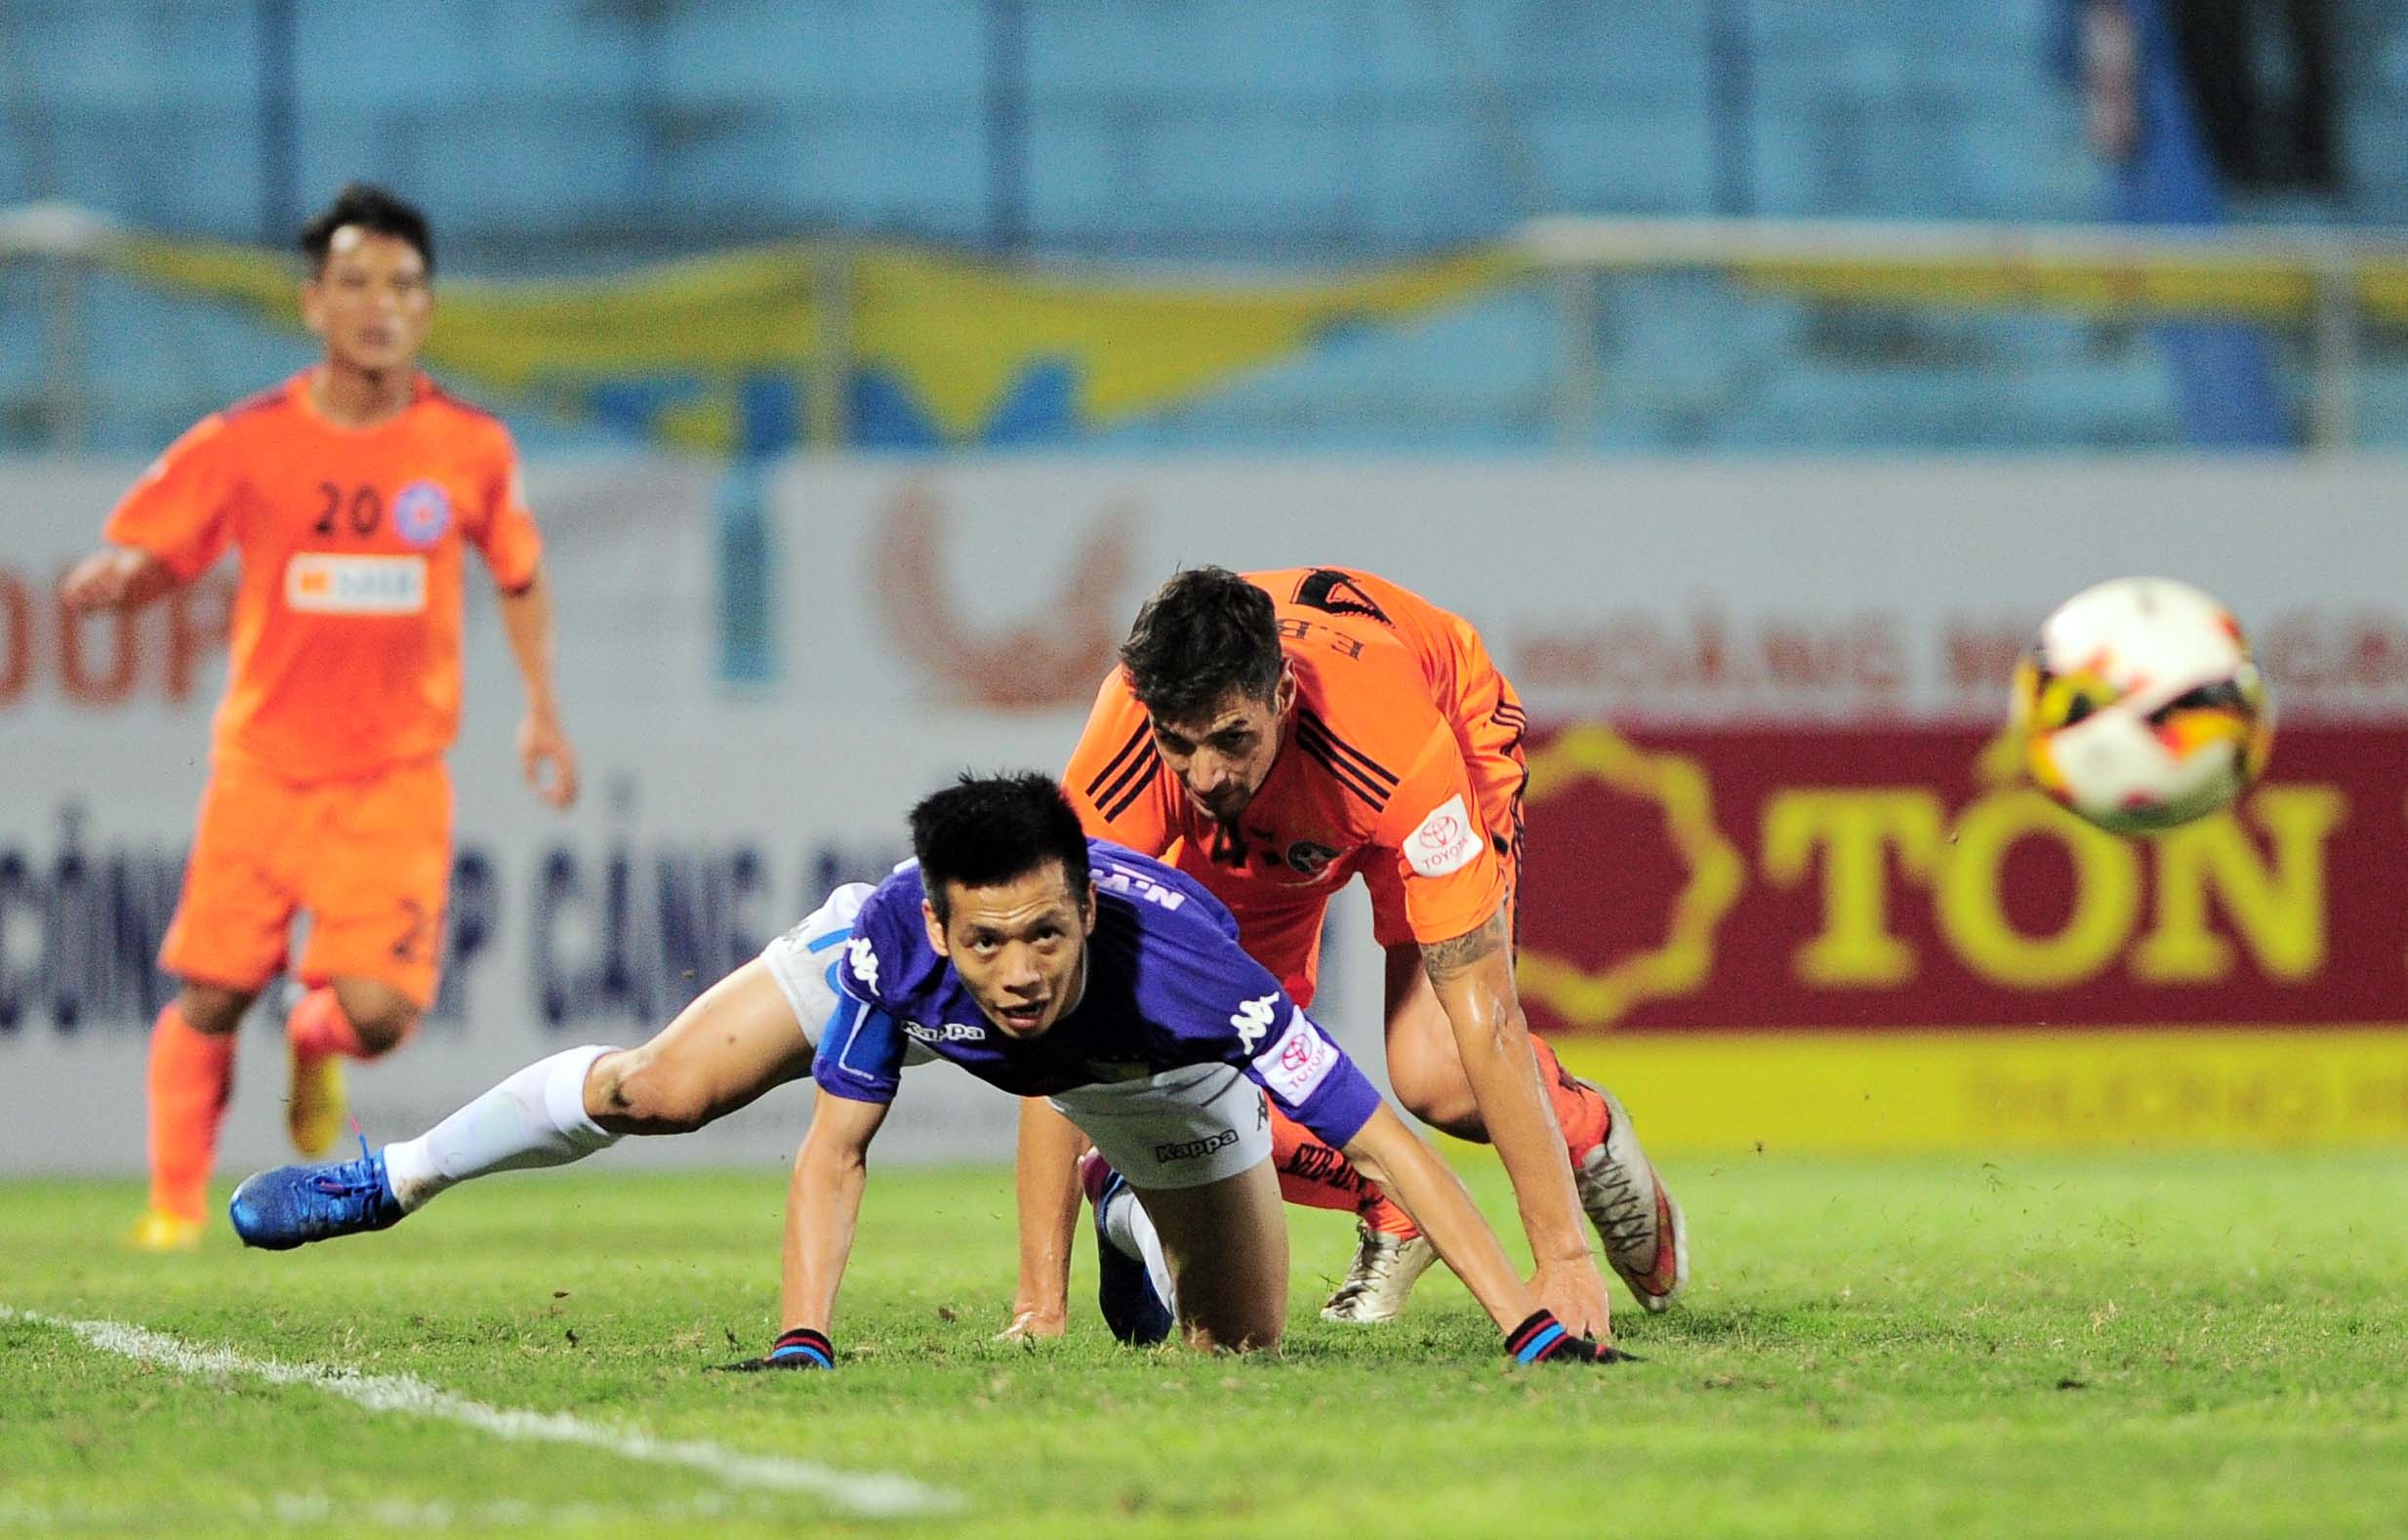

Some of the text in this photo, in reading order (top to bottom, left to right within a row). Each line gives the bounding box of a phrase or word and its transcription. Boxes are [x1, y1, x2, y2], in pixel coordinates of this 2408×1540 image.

[315, 481, 383, 536] 20
[902, 1020, 985, 1042] Kappa
[1156, 1129, 1240, 1162] Kappa
